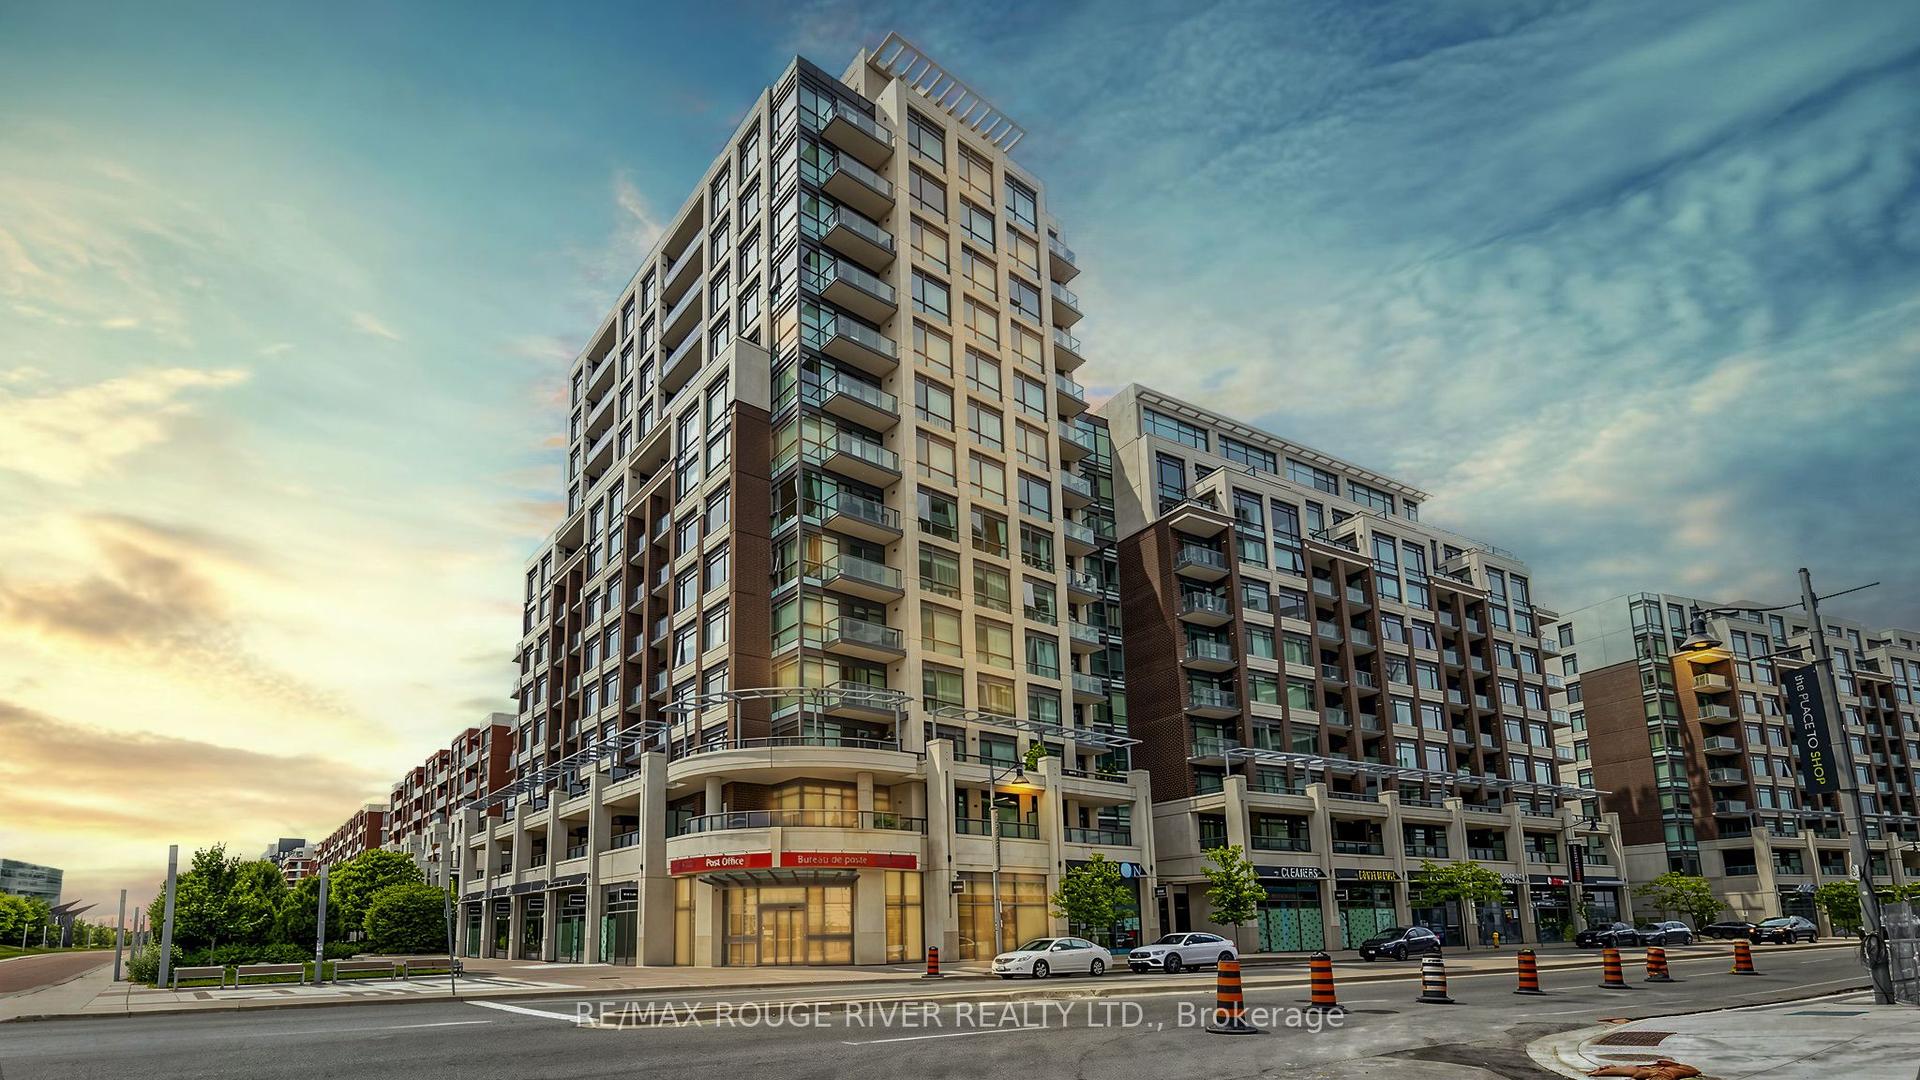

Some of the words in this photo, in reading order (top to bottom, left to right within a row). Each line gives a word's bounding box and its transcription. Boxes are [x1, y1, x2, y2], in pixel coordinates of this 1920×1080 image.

[1794, 674, 1805, 692] the
[1799, 693, 1816, 730] PLACE
[1807, 730, 1819, 749] TO
[1810, 751, 1826, 785] SHOP
[706, 858, 721, 867] Post
[721, 857, 744, 866] Office
[797, 855, 829, 864] Bureau
[831, 856, 843, 864] de
[845, 856, 868, 866] poste
[1281, 867, 1318, 878] CLEANERS
